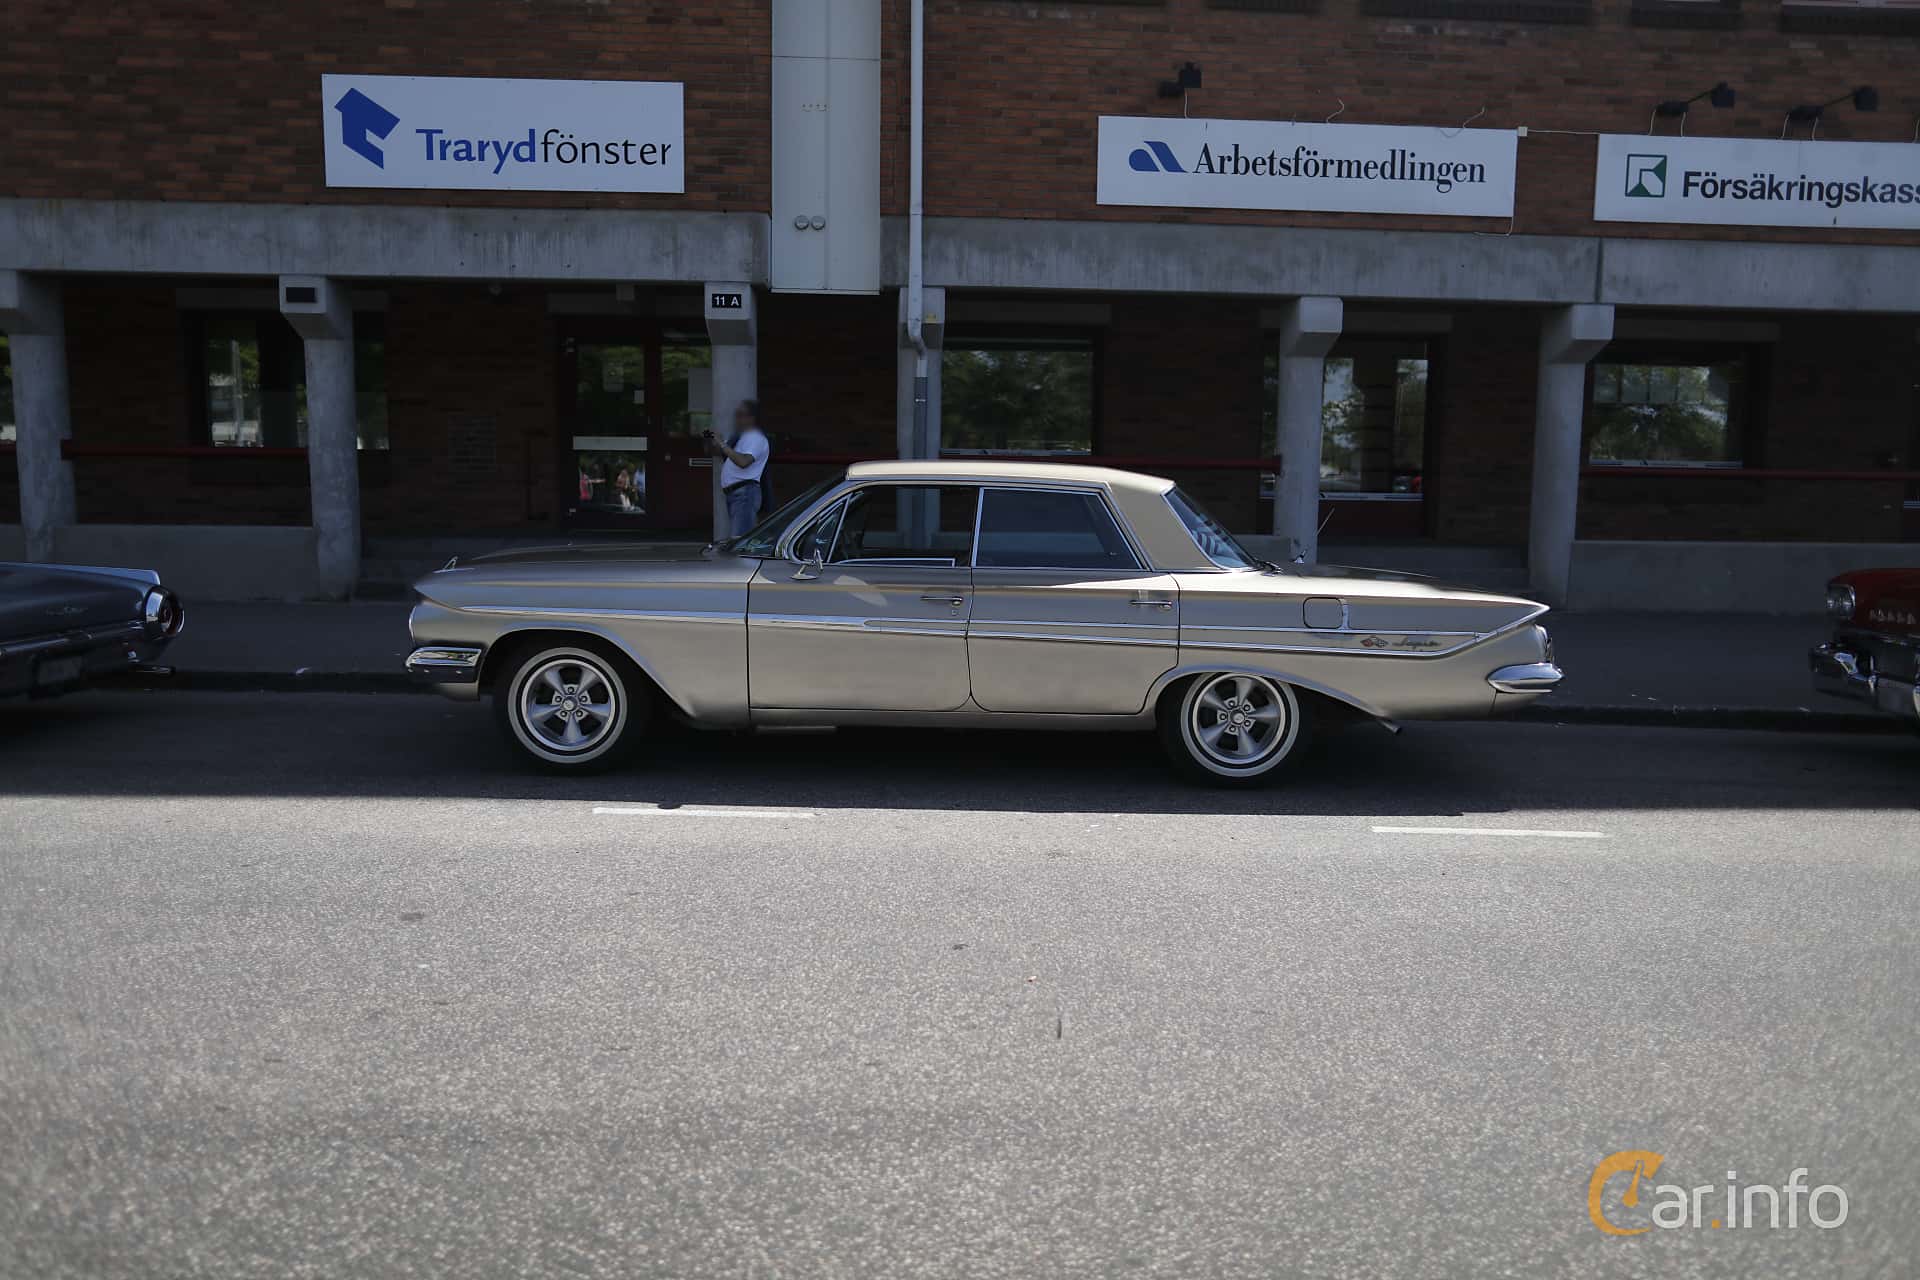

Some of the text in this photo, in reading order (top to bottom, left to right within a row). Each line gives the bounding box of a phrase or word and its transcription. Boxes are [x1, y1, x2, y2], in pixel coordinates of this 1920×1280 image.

[1192, 143, 1486, 193] Arbetsförmedlingen
[714, 296, 740, 306] 11 A
